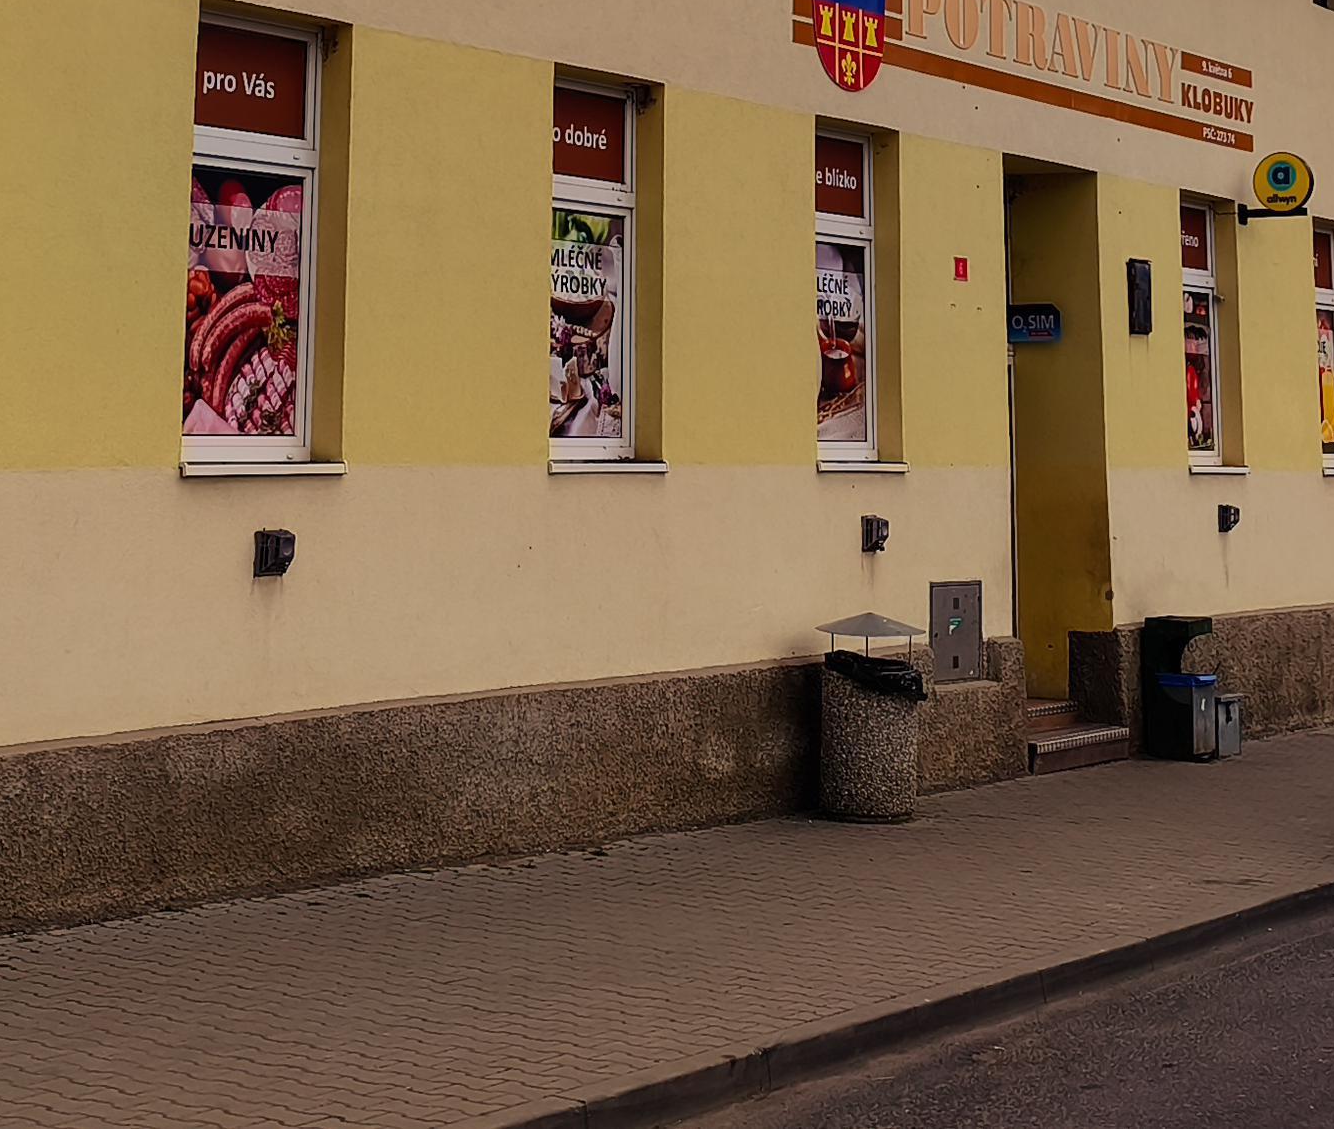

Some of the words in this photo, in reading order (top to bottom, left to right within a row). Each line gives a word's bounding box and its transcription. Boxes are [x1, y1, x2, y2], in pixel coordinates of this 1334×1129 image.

[203, 71, 237, 94] pro
[242, 72, 275, 99] Vás
[1181, 82, 1254, 124] KLOBUKY
[565, 123, 607, 150] dobré
[1267, 193, 1297, 206] allwyn
[189, 223, 279, 253] UZENINY
[551, 269, 607, 296] ÝROBKY
[817, 273, 849, 295] LÉČNÉ
[817, 298, 852, 318] ROBKY
[1028, 314, 1055, 329] SIM
